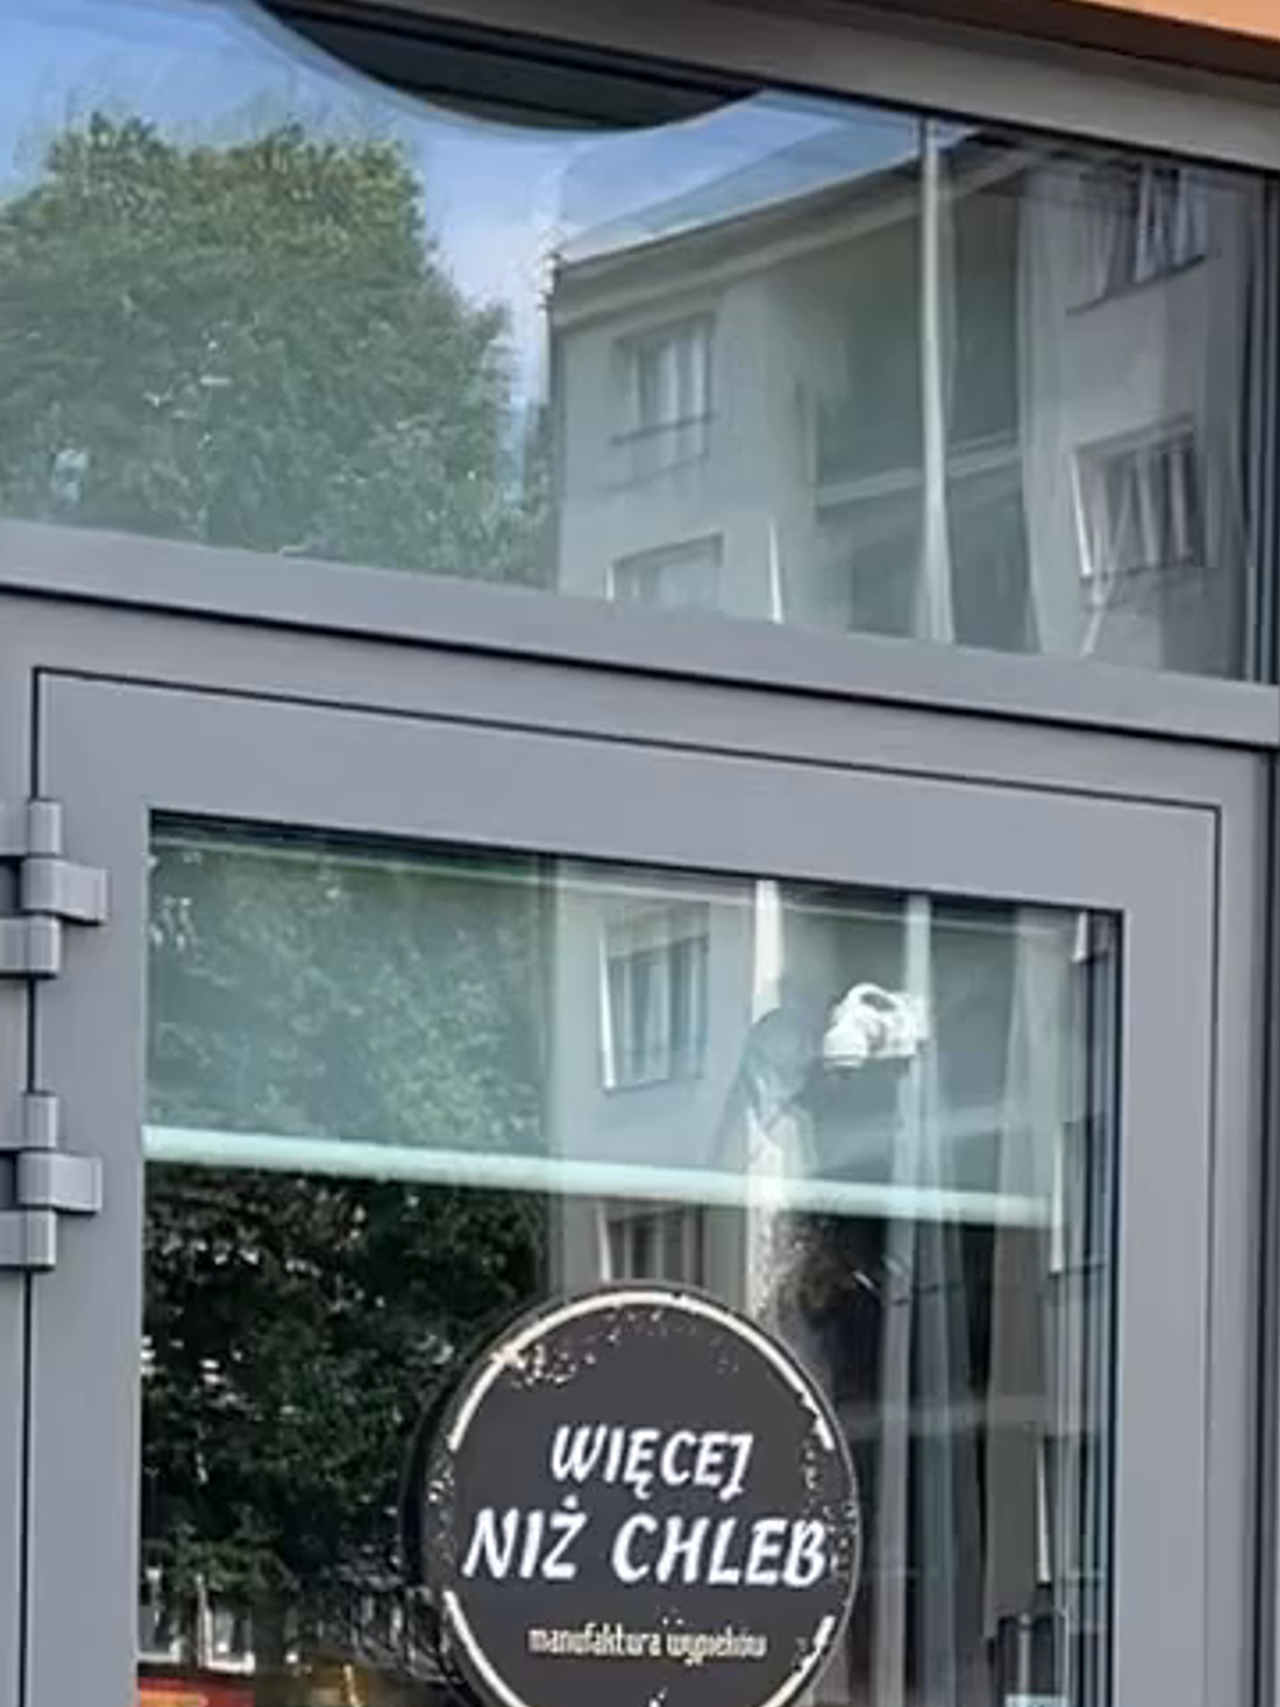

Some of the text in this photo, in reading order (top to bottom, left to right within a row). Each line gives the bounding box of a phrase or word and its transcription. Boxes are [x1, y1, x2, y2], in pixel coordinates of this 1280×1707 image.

[551, 1424, 754, 1502] WIĘCEJ
[462, 1494, 825, 1586] NIŻ CHLEB
[528, 1621, 662, 1657] manufaktura
